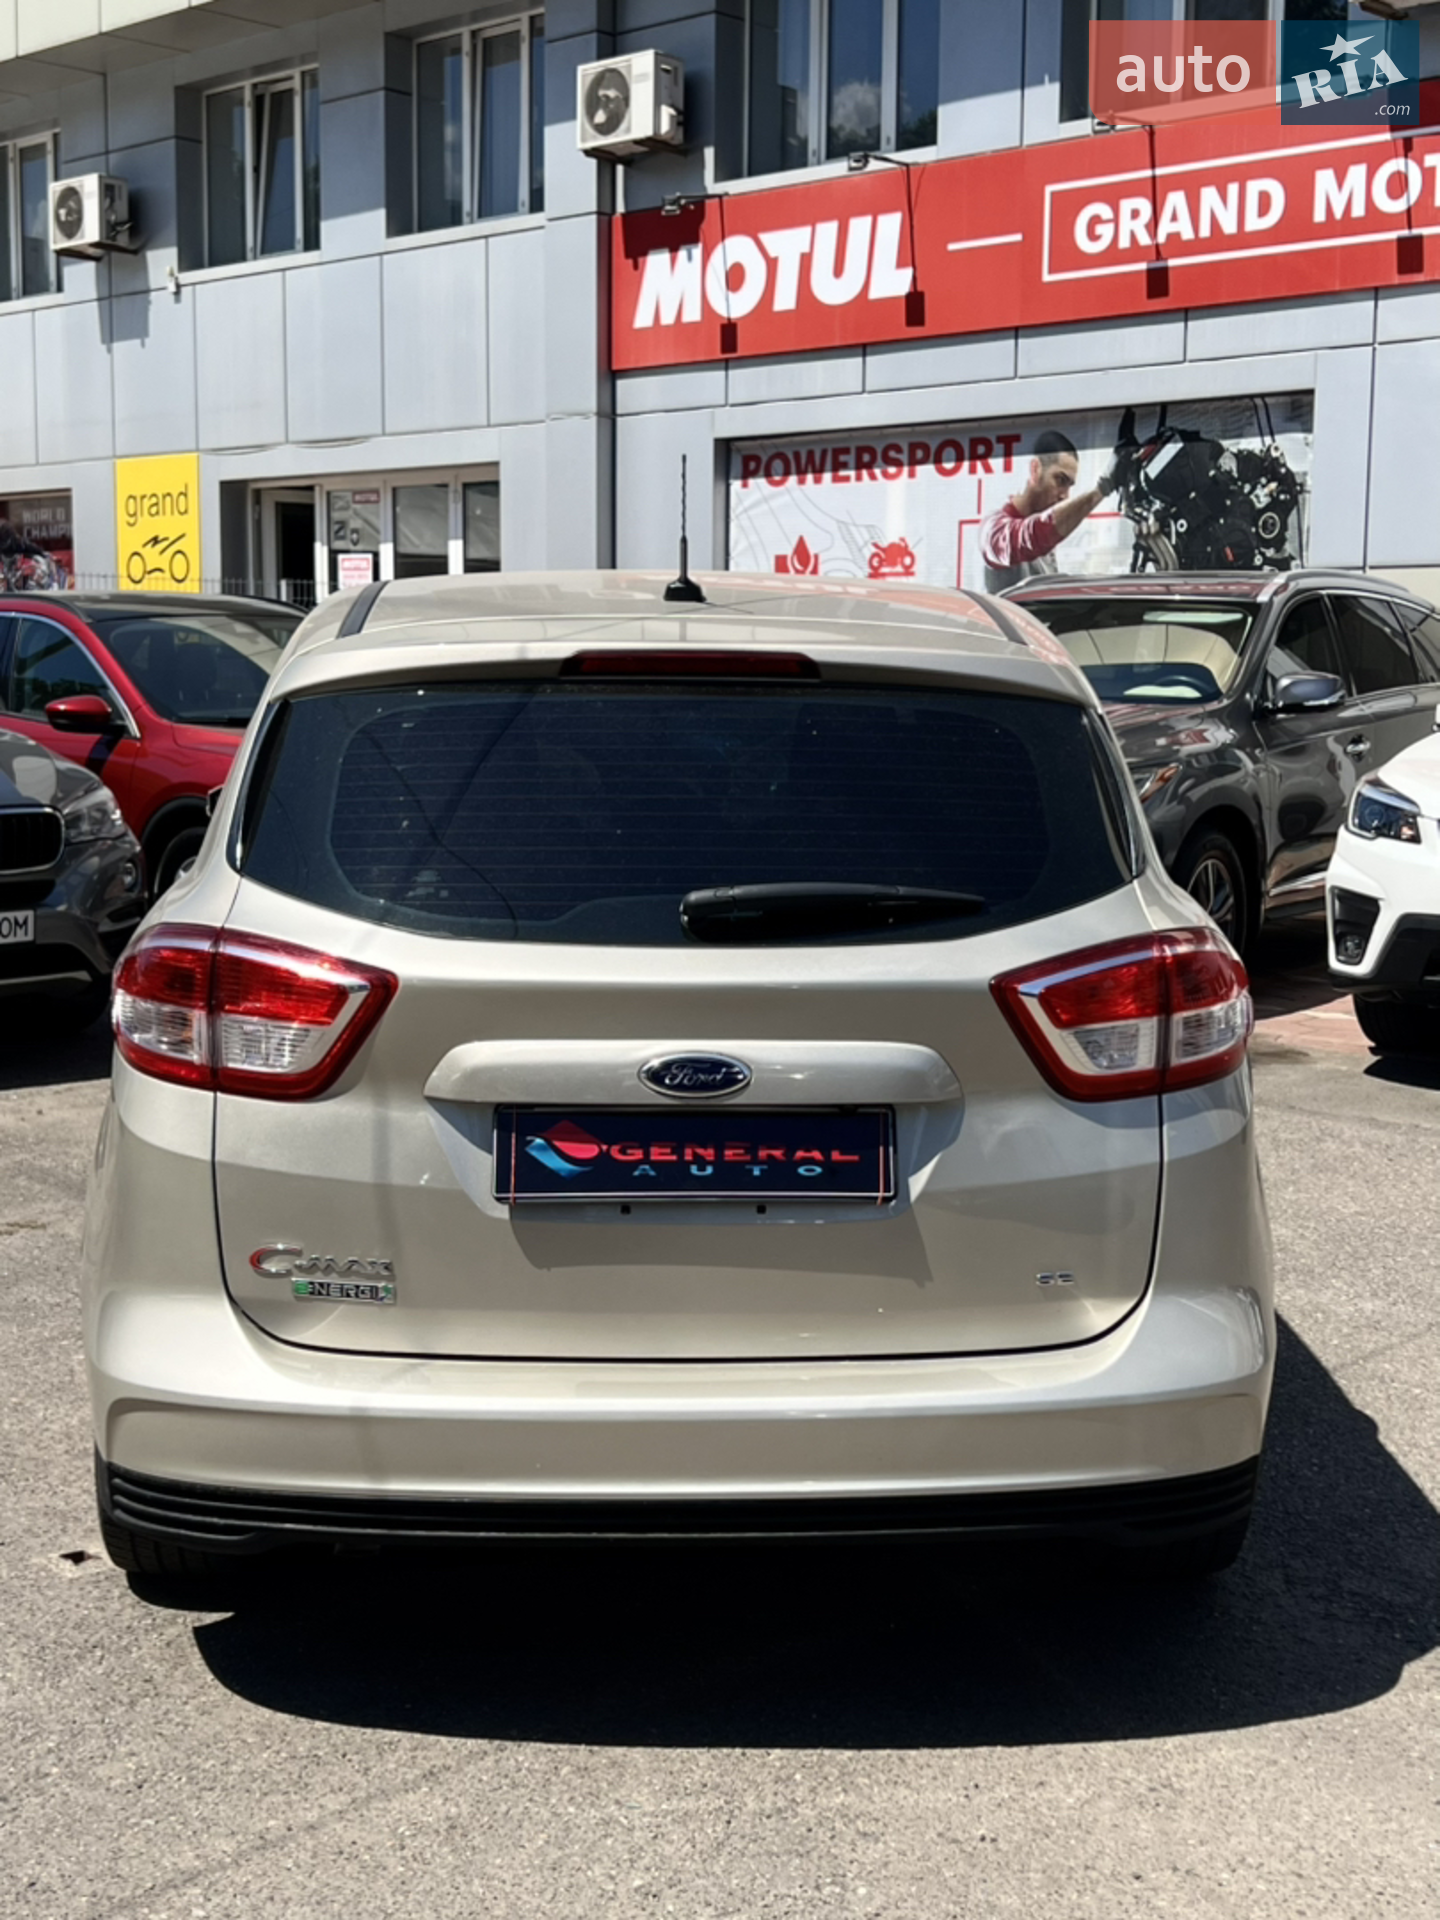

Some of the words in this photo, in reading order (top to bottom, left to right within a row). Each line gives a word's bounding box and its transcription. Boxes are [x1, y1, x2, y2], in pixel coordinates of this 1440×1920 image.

[632, 211, 914, 329] MOTUL
[1074, 177, 1286, 254] GRAND
[741, 434, 1021, 488] POWERSPORT
[22, 507, 66, 523] WORLD
[125, 483, 188, 527] grand
[660, 1062, 727, 1087] Ford
[608, 1142, 860, 1162] GENERAL
[632, 1164, 823, 1177] AUTO
[1035, 1271, 1074, 1287] SE
